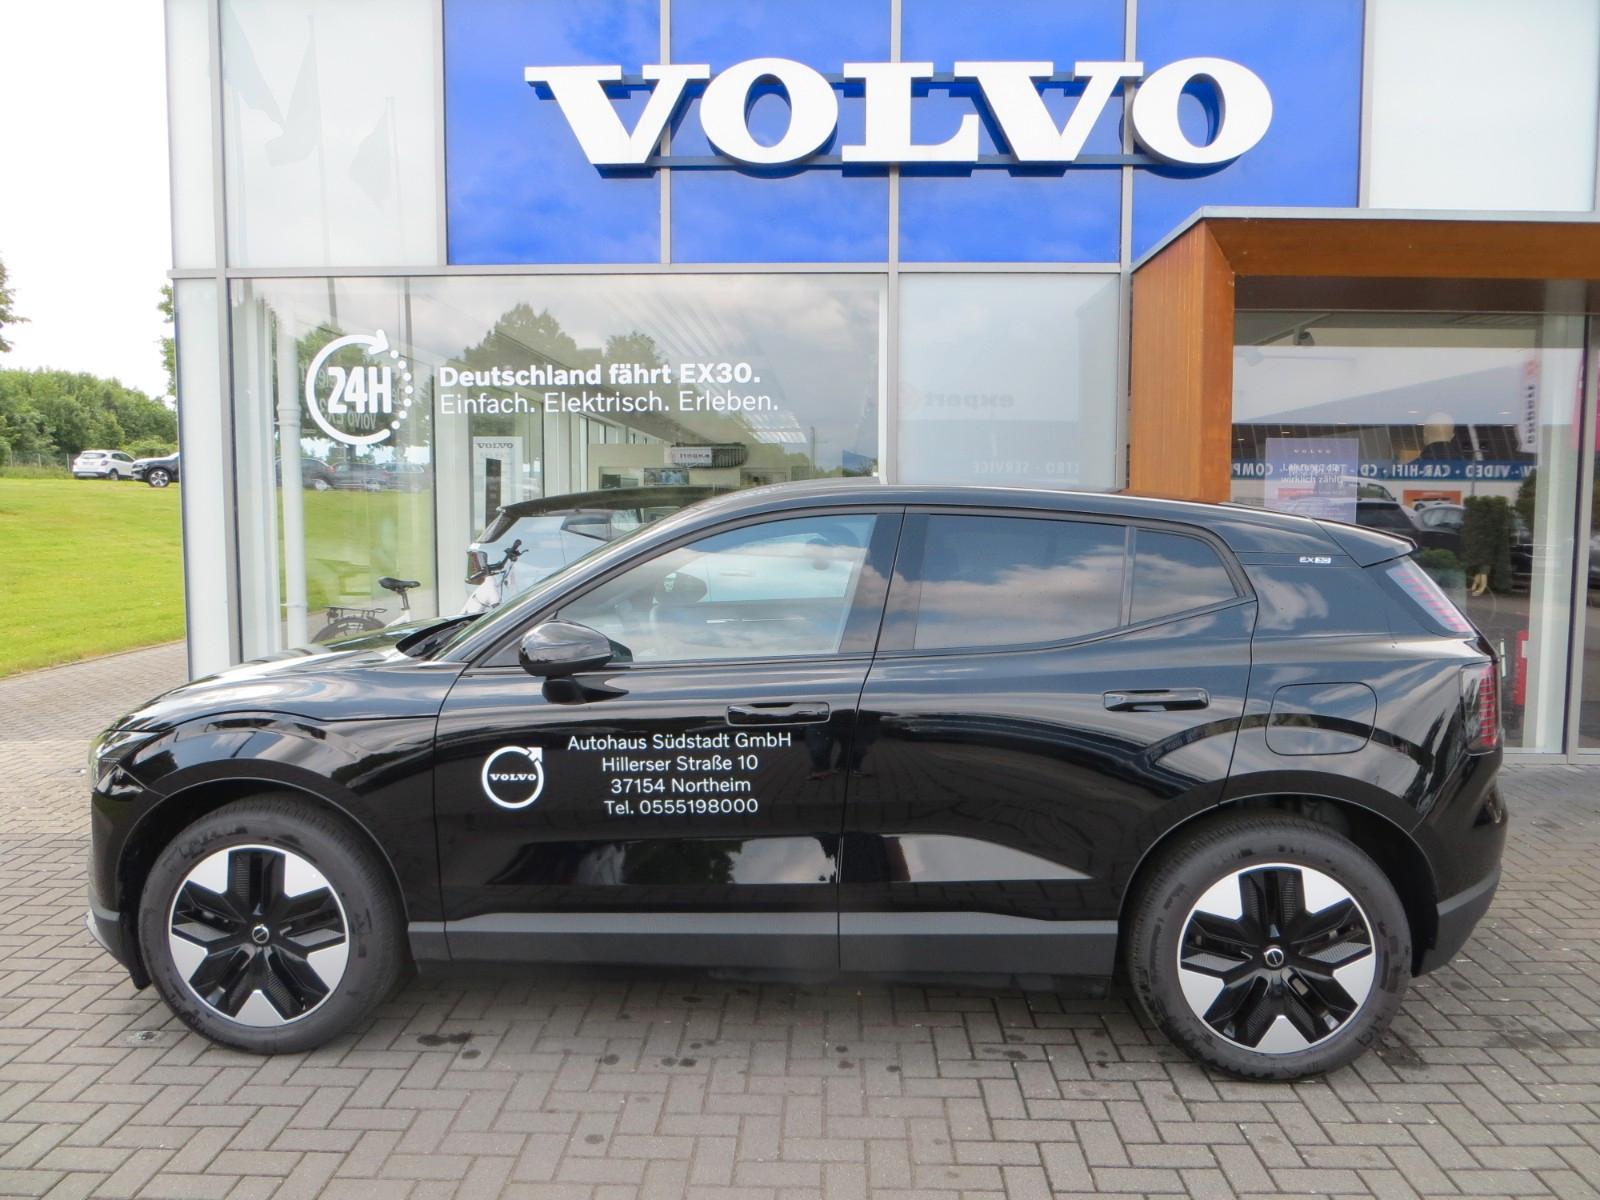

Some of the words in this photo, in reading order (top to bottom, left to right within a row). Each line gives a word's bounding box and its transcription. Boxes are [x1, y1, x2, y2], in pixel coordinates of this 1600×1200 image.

[525, 57, 1273, 165] VOLVO
[439, 364, 602, 387] Deutschland
[608, 363, 672, 385] fährt
[679, 362, 761, 384] EX30.
[327, 366, 392, 414] 24H
[441, 392, 535, 414] Einfach.
[544, 391, 670, 413] Elektrisch.
[679, 390, 779, 412] Erleben.
[566, 735, 647, 751] Autohaus
[652, 733, 730, 749] Südstadt
[735, 732, 792, 748] GmbH
[602, 757, 671, 772] Hillerser
[676, 755, 733, 771] Straße
[738, 755, 759, 770] 10
[489, 773, 537, 781] VOLVO
[610, 778, 666, 794] 37154
[671, 777, 752, 793] Northeim
[603, 800, 635, 815] Tel.
[639, 798, 759, 815] 0555198000
